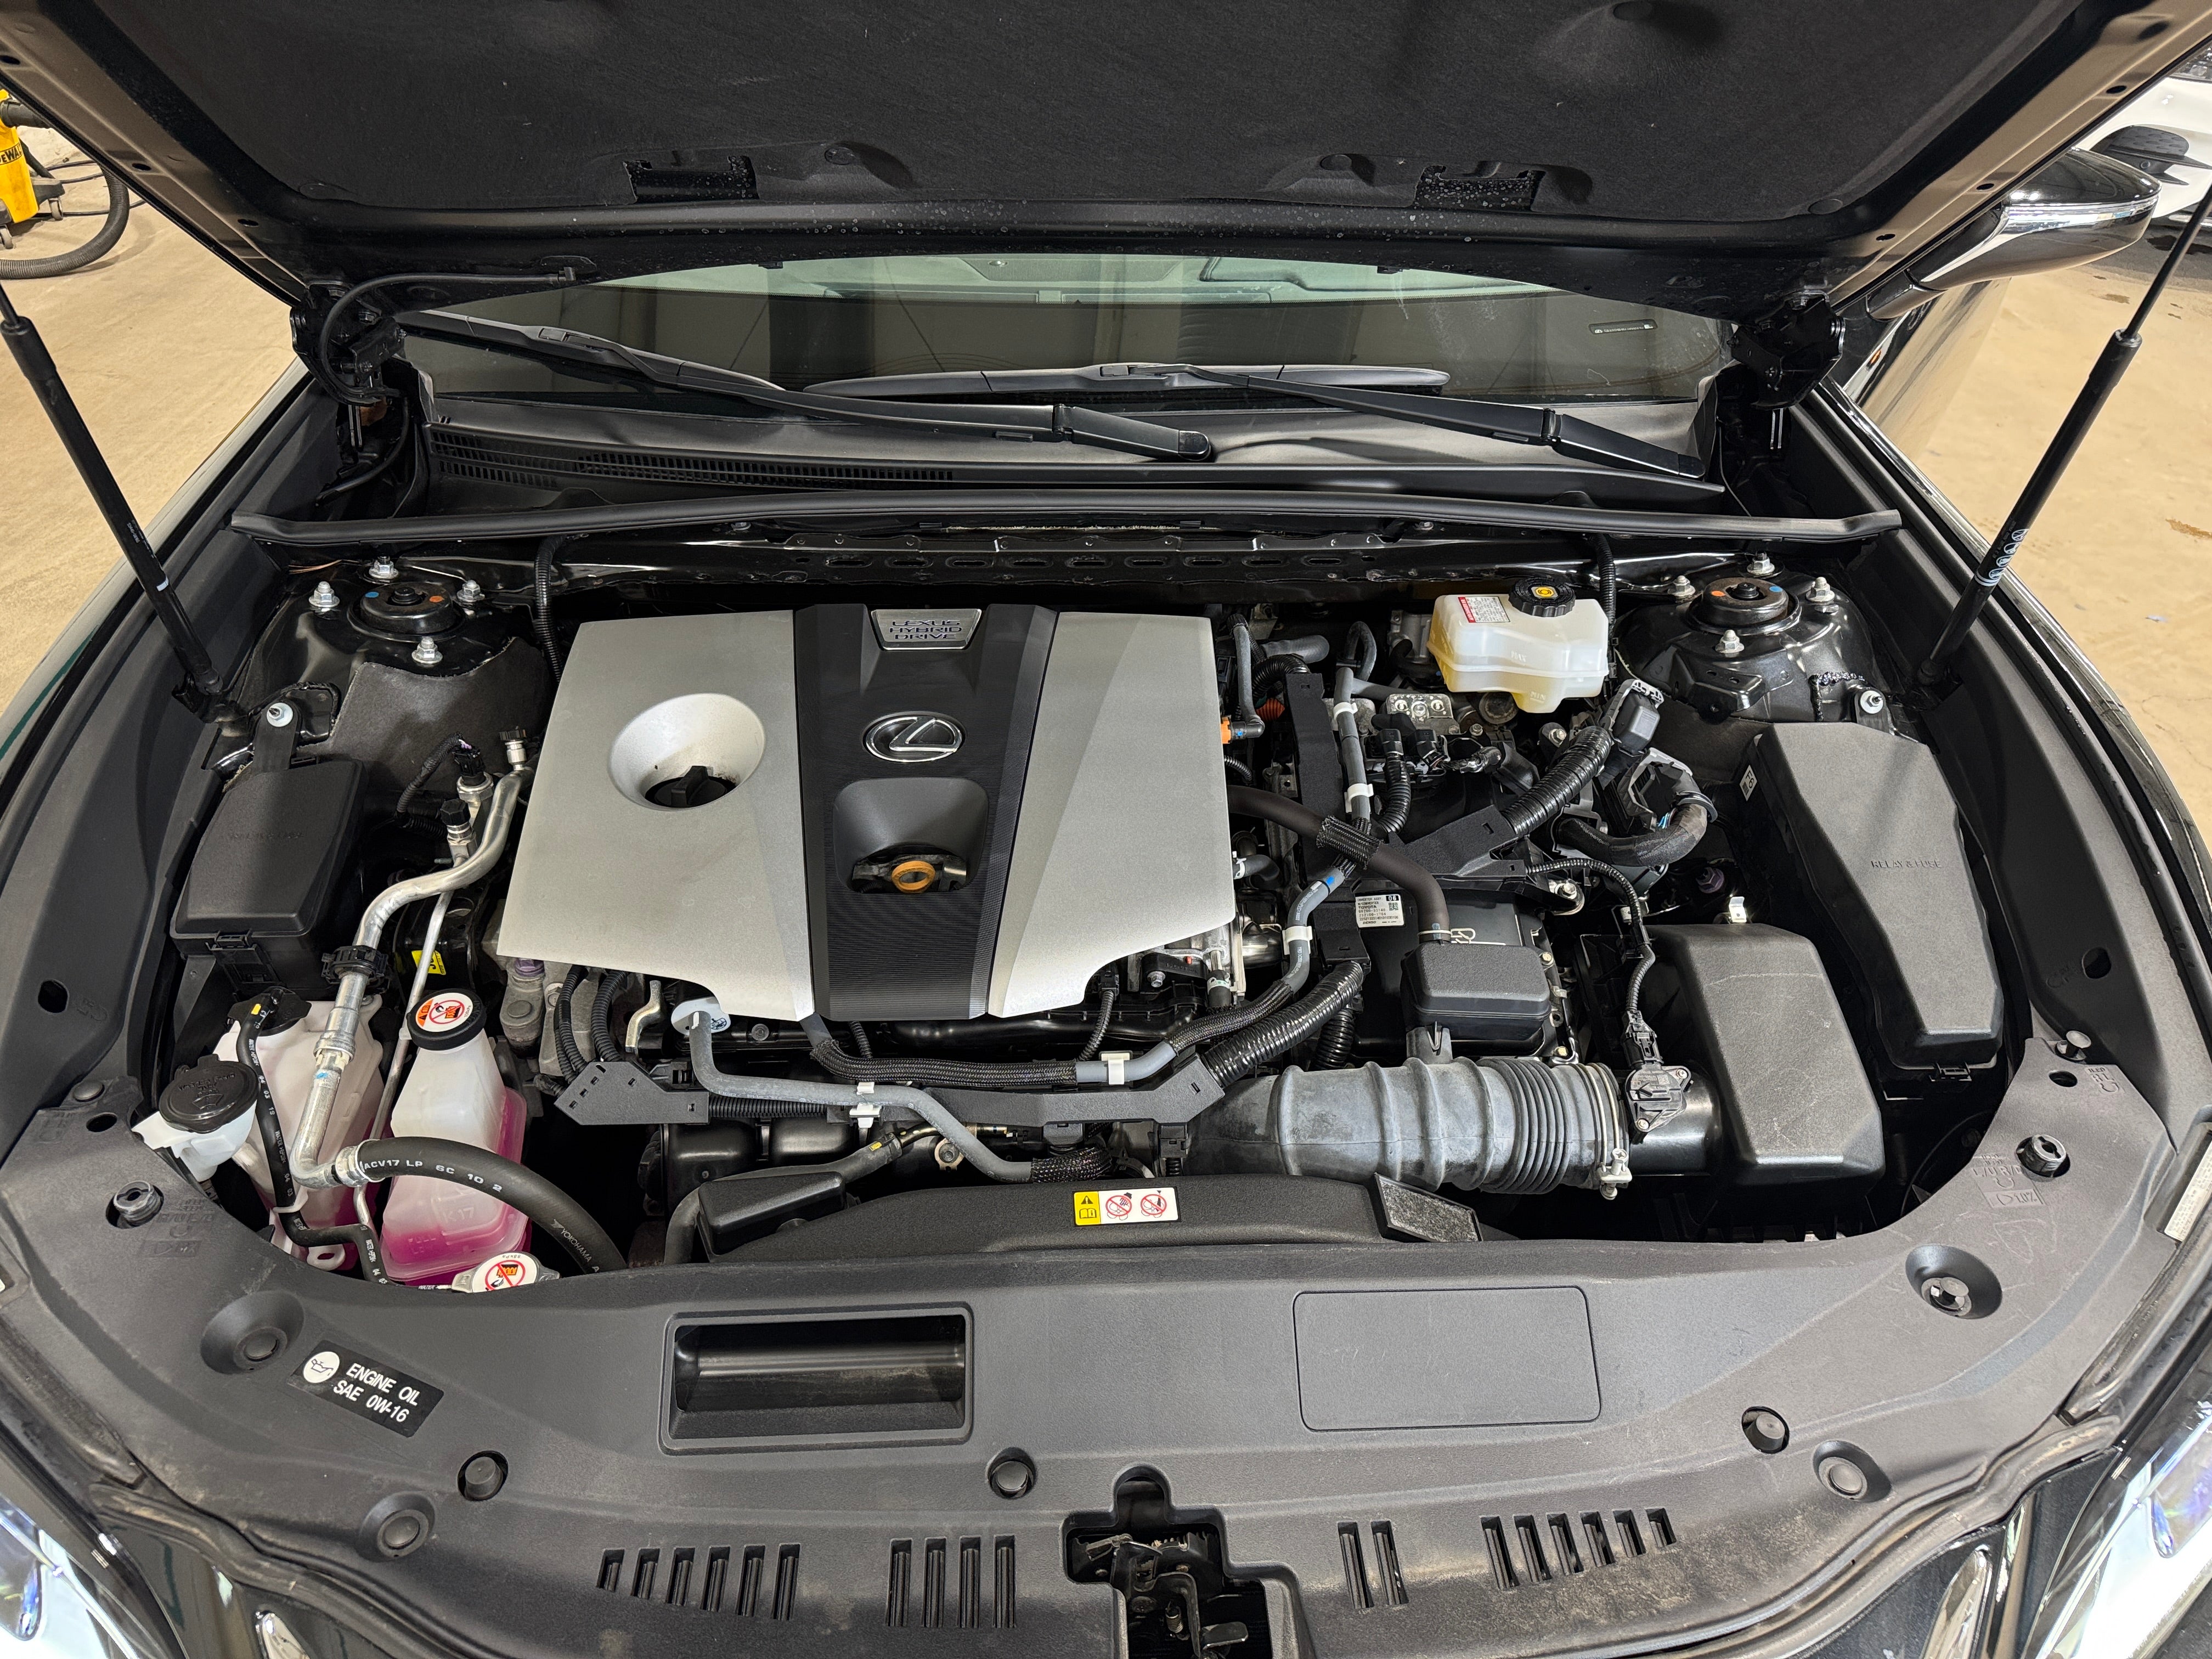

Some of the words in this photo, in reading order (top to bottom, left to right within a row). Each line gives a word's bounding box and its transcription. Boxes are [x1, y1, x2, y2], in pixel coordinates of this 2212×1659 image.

[1531, 691, 1545, 701] MIN
[1745, 770, 1754, 789] F6
[1870, 860, 1903, 868] RELAY
[1915, 860, 1943, 868] FUSE
[364, 1159, 400, 1170] ACV17
[467, 1173, 484, 1184] 10
[492, 1184, 503, 1192] 2
[442, 1206, 475, 1224] K17
[560, 1228, 592, 1262] YOKOHAMA
[346, 1363, 397, 1393] ENGINE
[398, 1386, 420, 1406] OIL
[333, 1380, 364, 1401] SAE
[366, 1395, 410, 1422] 0W-16
